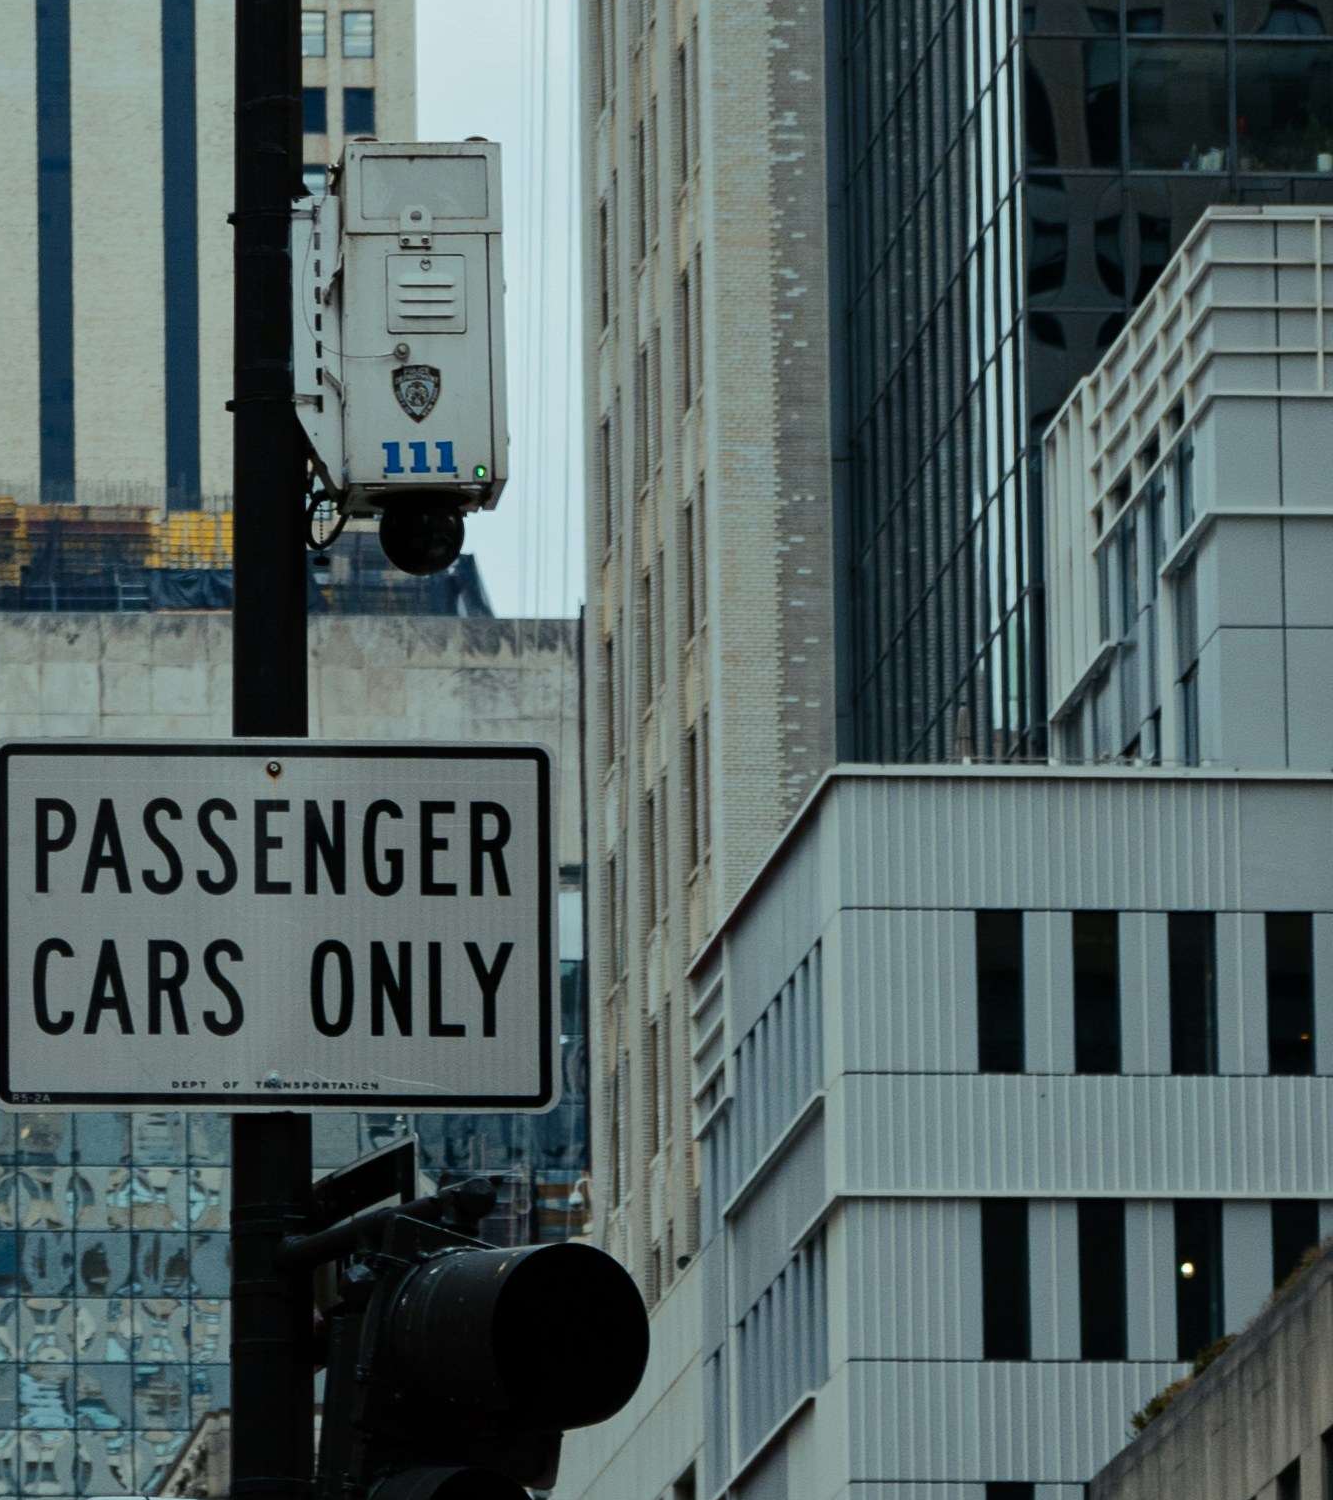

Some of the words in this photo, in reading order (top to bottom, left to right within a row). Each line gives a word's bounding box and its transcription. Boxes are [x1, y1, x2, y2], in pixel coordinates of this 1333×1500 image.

[382, 441, 457, 473] 111
[35, 798, 511, 896] PASSENGER
[34, 938, 244, 1036] CARS
[310, 939, 514, 1037] ONLY
[171, 1080, 207, 1089] DEPT
[222, 1080, 240, 1089] OF
